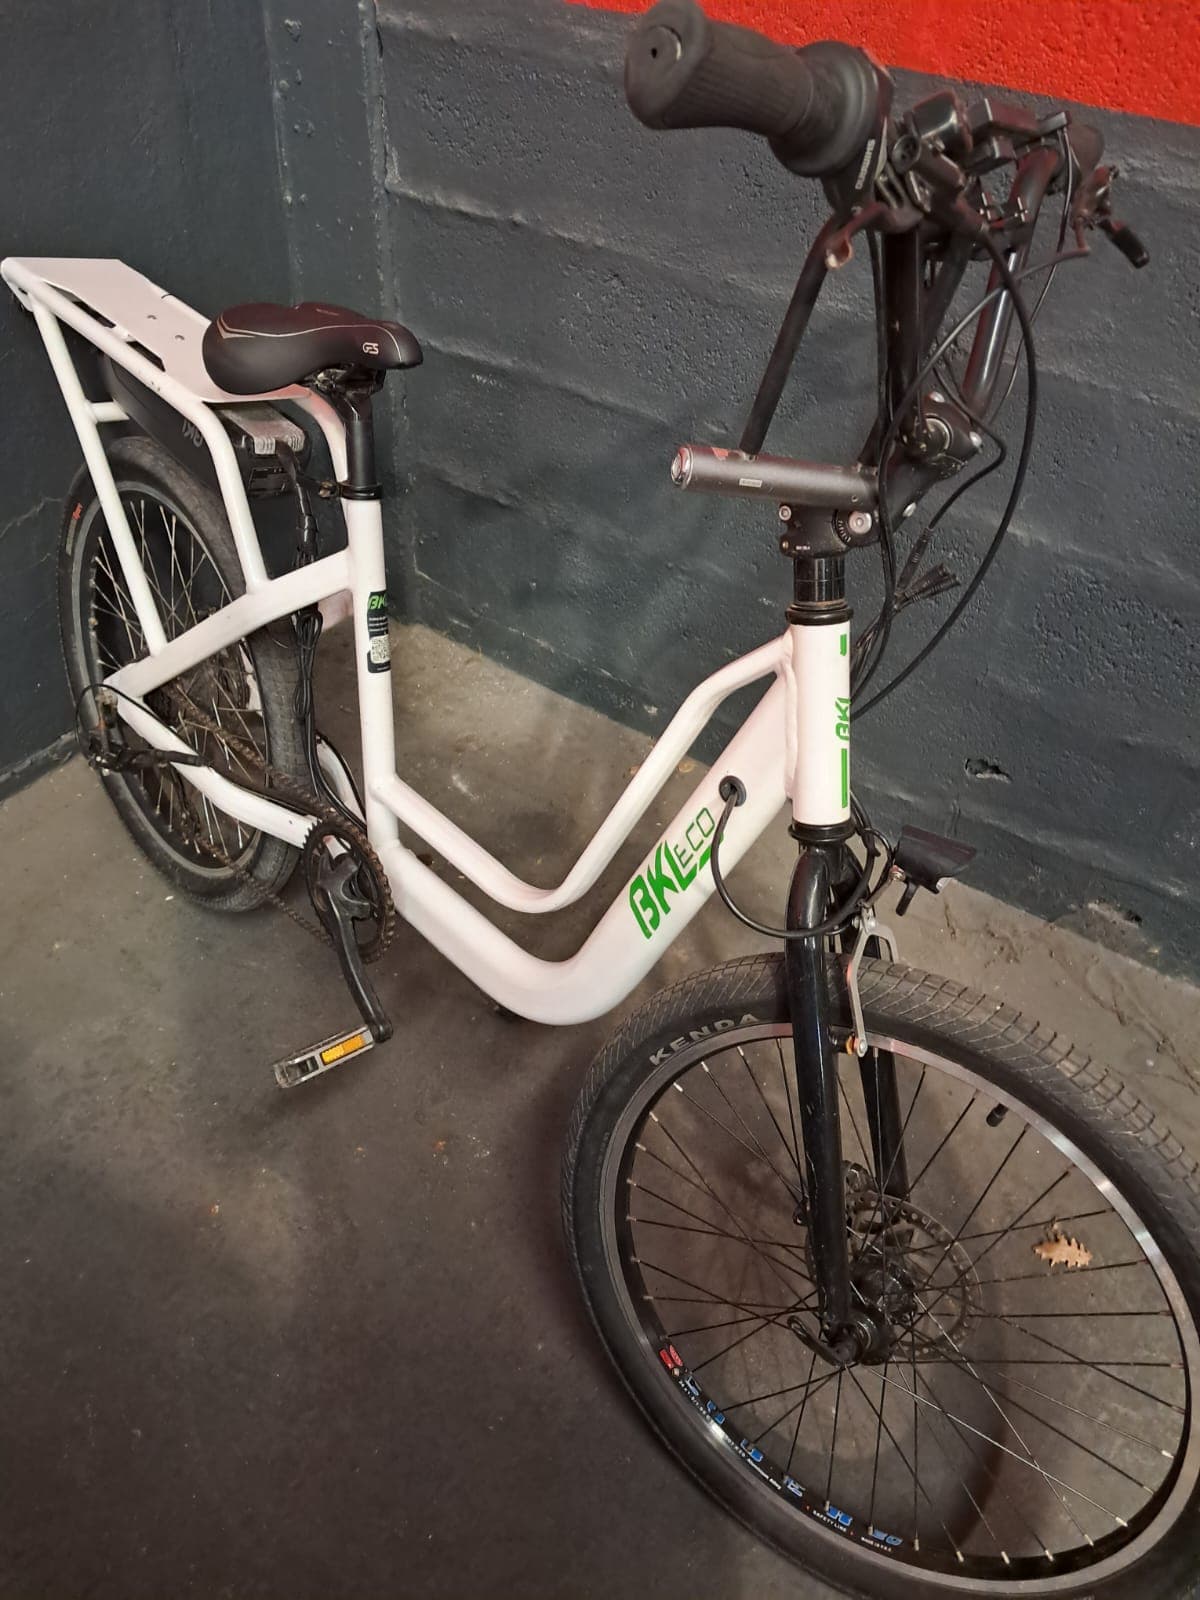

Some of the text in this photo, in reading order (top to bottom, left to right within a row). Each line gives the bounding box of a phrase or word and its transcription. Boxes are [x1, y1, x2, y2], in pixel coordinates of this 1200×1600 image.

[629, 807, 715, 940] BKL ECO
[649, 1013, 759, 1066] KENDA
